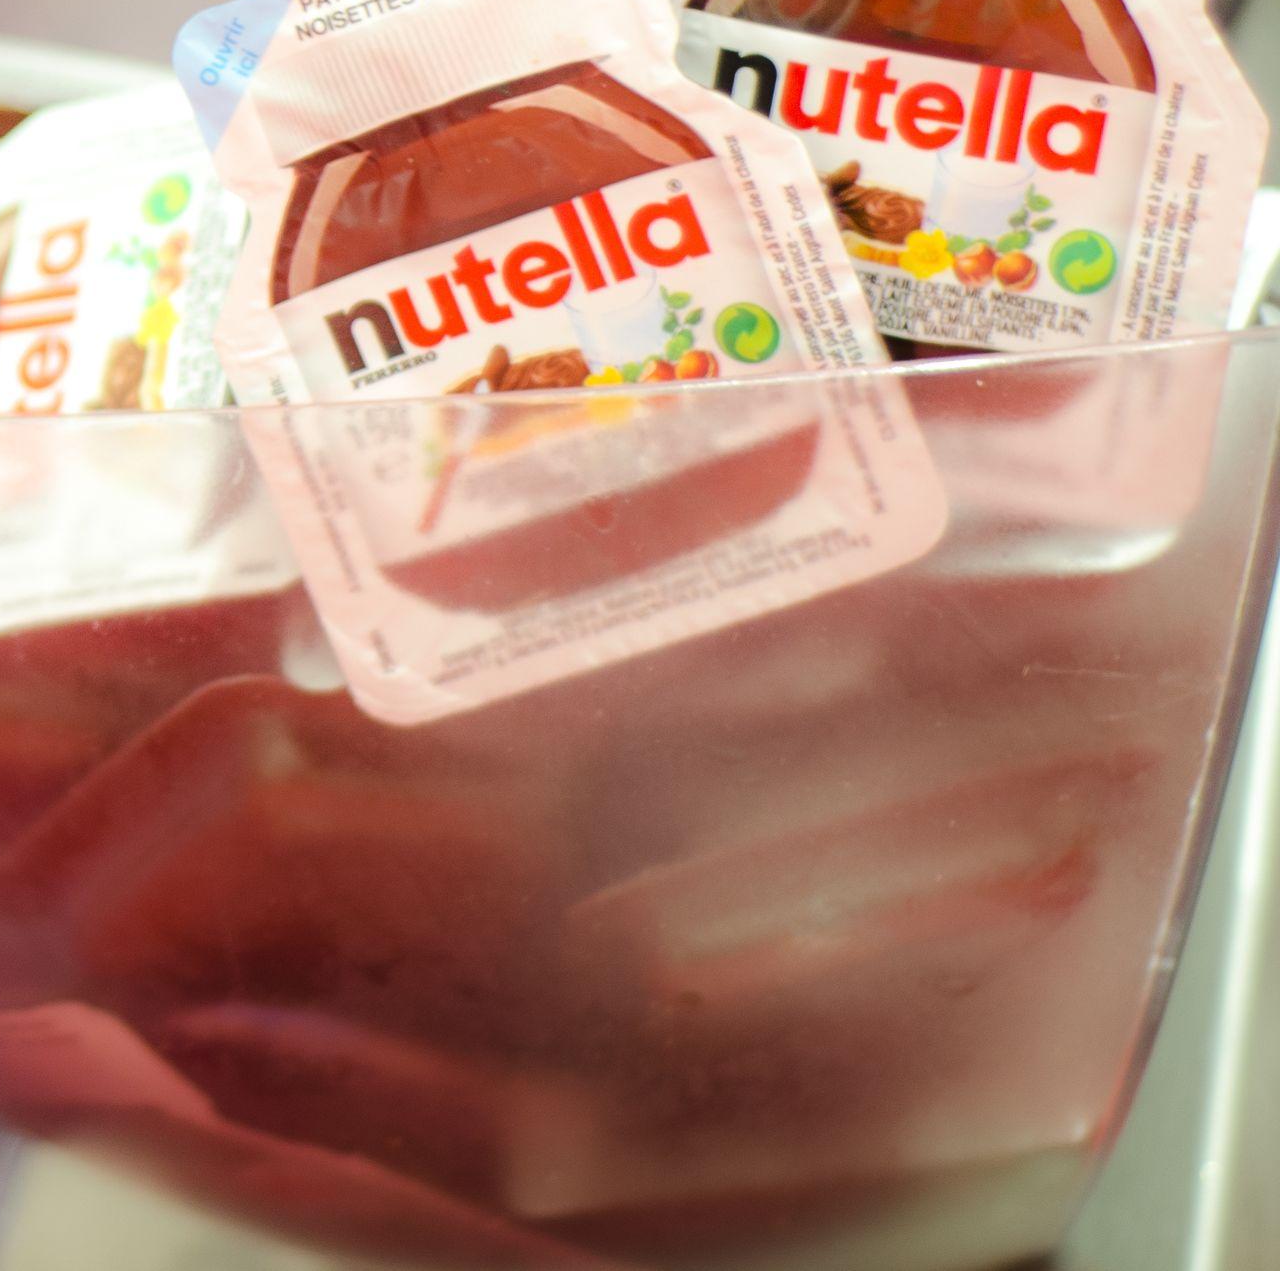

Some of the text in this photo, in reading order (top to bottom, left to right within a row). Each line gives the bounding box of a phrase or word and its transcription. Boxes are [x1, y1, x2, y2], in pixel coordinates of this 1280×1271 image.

[200, 19, 245, 85] Ouvrir
[233, 49, 257, 77] ici
[712, 47, 1108, 175] nutella
[1158, 202, 1178, 242] France
[786, 240, 810, 282] France
[1149, 246, 1169, 289] Ferrero
[323, 190, 711, 376] nutella
[800, 282, 826, 327] Ferrero
[352, 351, 438, 390] FERRERO
